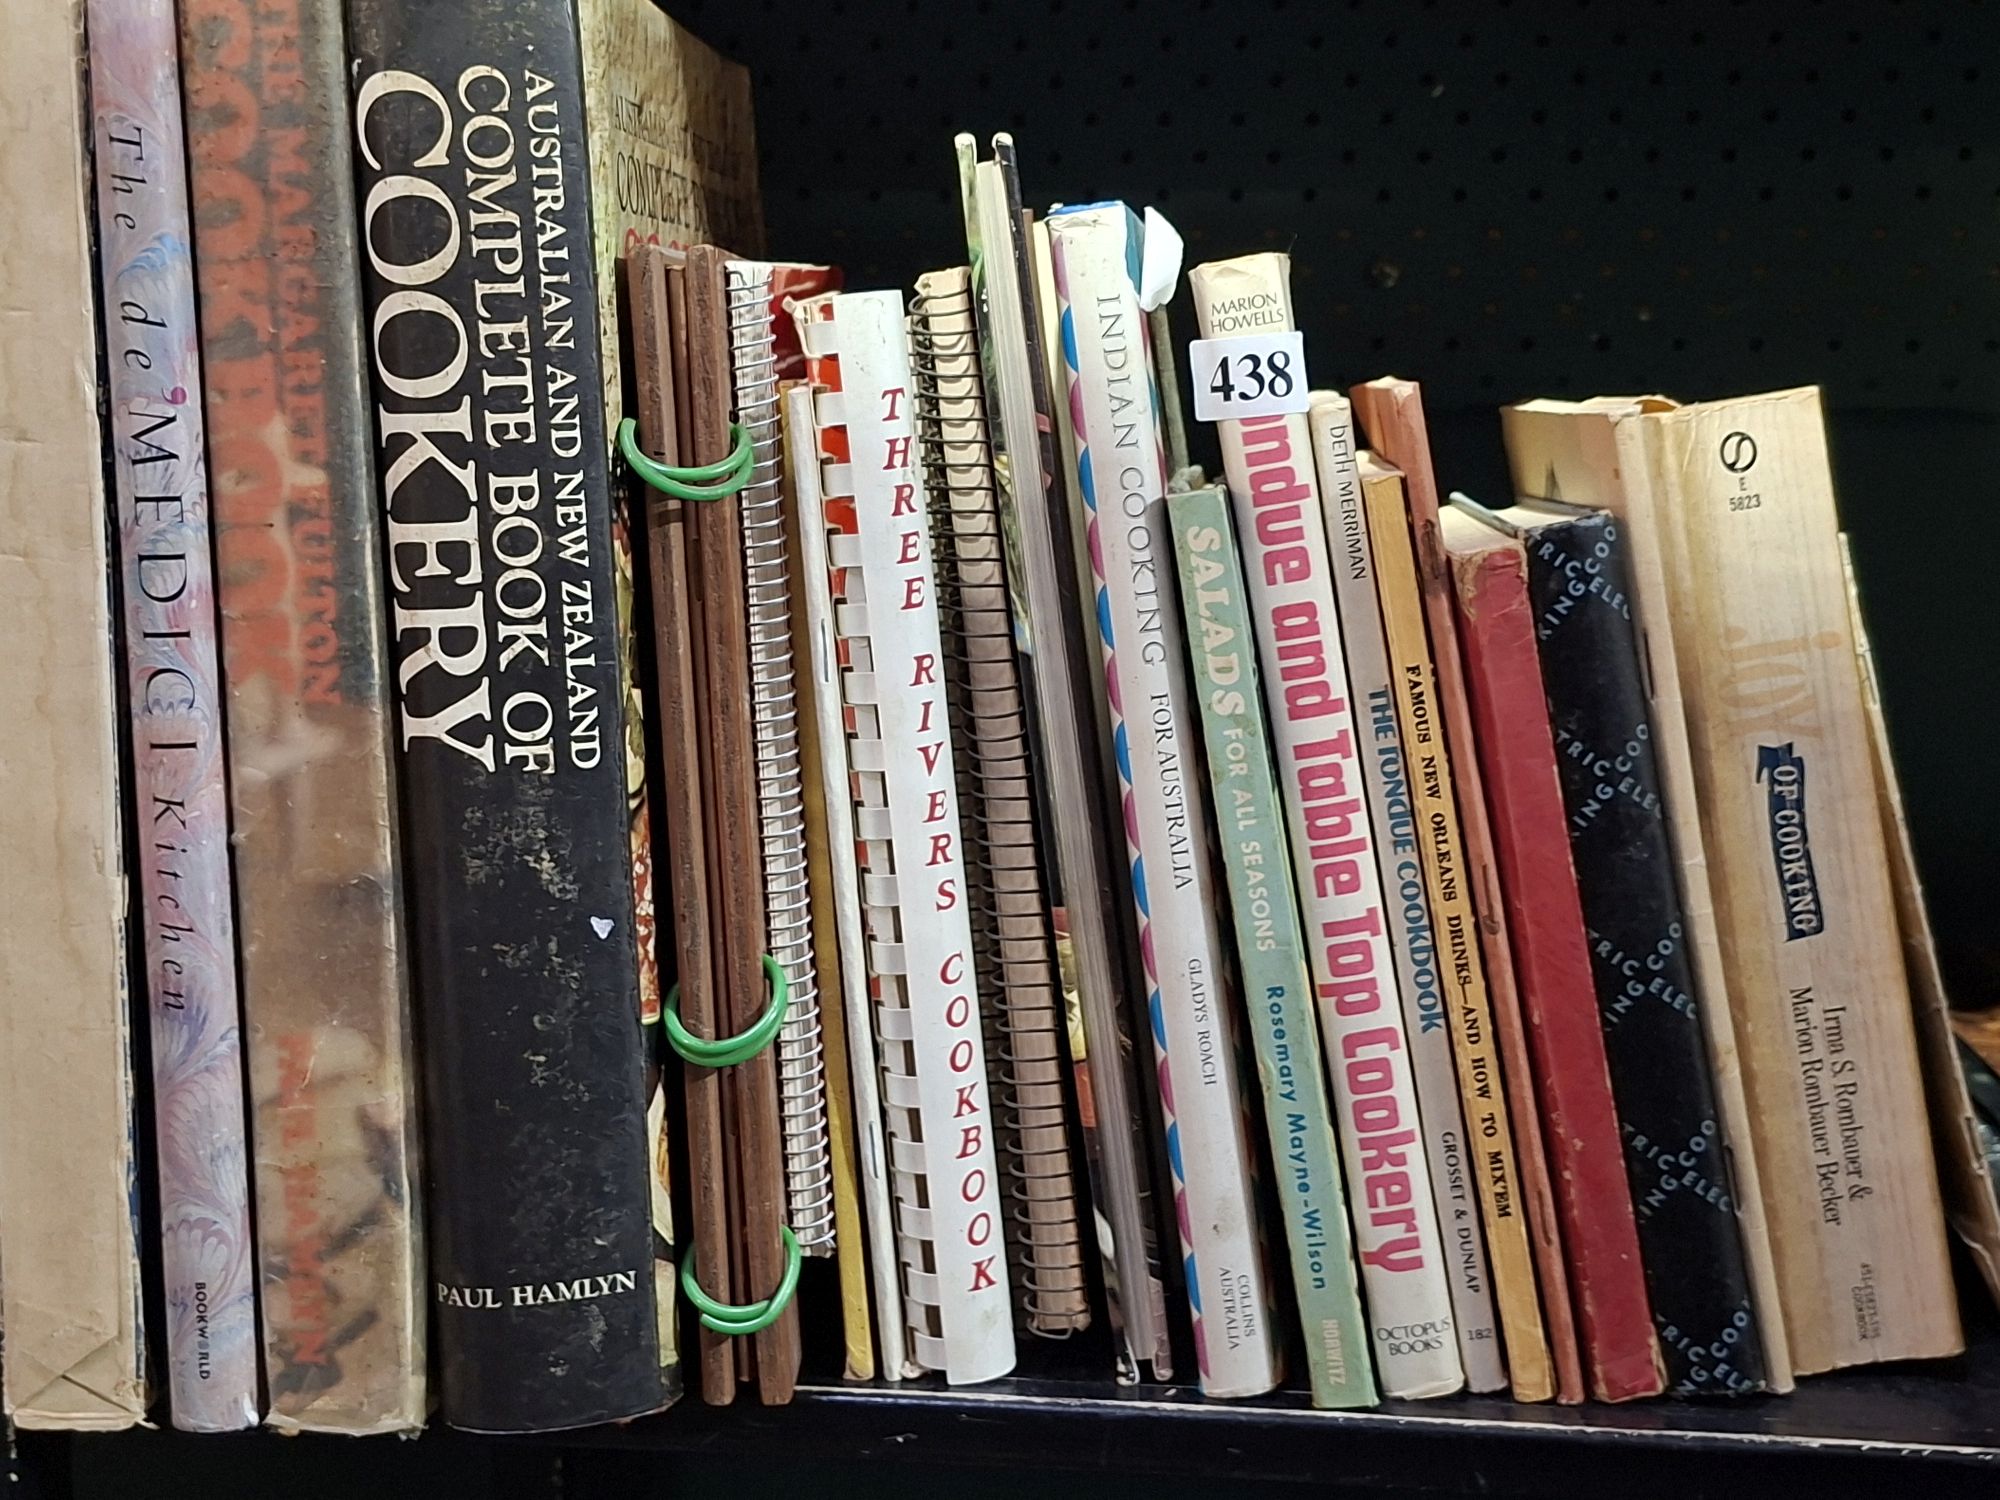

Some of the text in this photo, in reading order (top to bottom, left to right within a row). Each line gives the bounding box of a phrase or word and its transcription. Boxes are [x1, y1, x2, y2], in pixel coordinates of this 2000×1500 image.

[189, 0, 294, 698] COOKBOOK
[260, 2, 341, 706] THE MARGARET FULTON
[1211, 292, 1278, 317] MARION
[1211, 308, 1284, 333] HOWELLS
[356, 70, 497, 774] COOKERY
[457, 64, 556, 776] COMPLETE BOOK OF
[524, 68, 601, 770] AUSTRALIAN AND NEW ZEALAND
[1210, 350, 1293, 402] 438
[1729, 494, 1761, 512] 5823
[1739, 476, 1747, 491] E
[108, 125, 143, 231] The
[152, 795, 196, 1013] Kitchen
[1097, 293, 1194, 890] INDIAN COOKING FOR AUSTRALIA
[1271, 600, 1345, 721] and
[1368, 684, 1397, 741] THE
[1187, 526, 1276, 952] SALADS FOR ALL SEASONS
[881, 388, 997, 1292] THREE RIVERS COOKBOOK
[1293, 729, 1372, 898] Table
[1773, 764, 1818, 930] OF COOKING
[1406, 664, 1432, 744] FAMOUS
[1421, 754, 1441, 799] NEW
[1431, 812, 1458, 902] ORLEANS
[1470, 1056, 1492, 1099] HOW
[1481, 1112, 1497, 1138] TO
[1318, 907, 1382, 1016] Top
[1187, 958, 1217, 1085] GLADYS ROACH
[1266, 985, 1297, 1102] Rosemary
[1822, 1005, 1847, 1055] Irma
[1341, 1026, 1425, 1273] Cookery
[1789, 986, 1844, 1227] Marion Rombauer Becker
[1833, 1081, 1864, 1179] Rombauer
[1441, 1131, 1480, 1293] GROSSET & DUNLAP
[1847, 1184, 1873, 1202] &
[195, 1282, 211, 1380] BOOKWORLD
[437, 1270, 637, 1308] PAUL HAMLYN
[1218, 1266, 1240, 1351] AUSTRALIA
[1237, 1274, 1256, 1338] COLLINS
[1376, 1316, 1450, 1342] OCTOPUS
[1468, 1327, 1492, 1341] 182
[1323, 1319, 1348, 1386] HORWITZ
[1389, 1336, 1443, 1356] BOOKS
